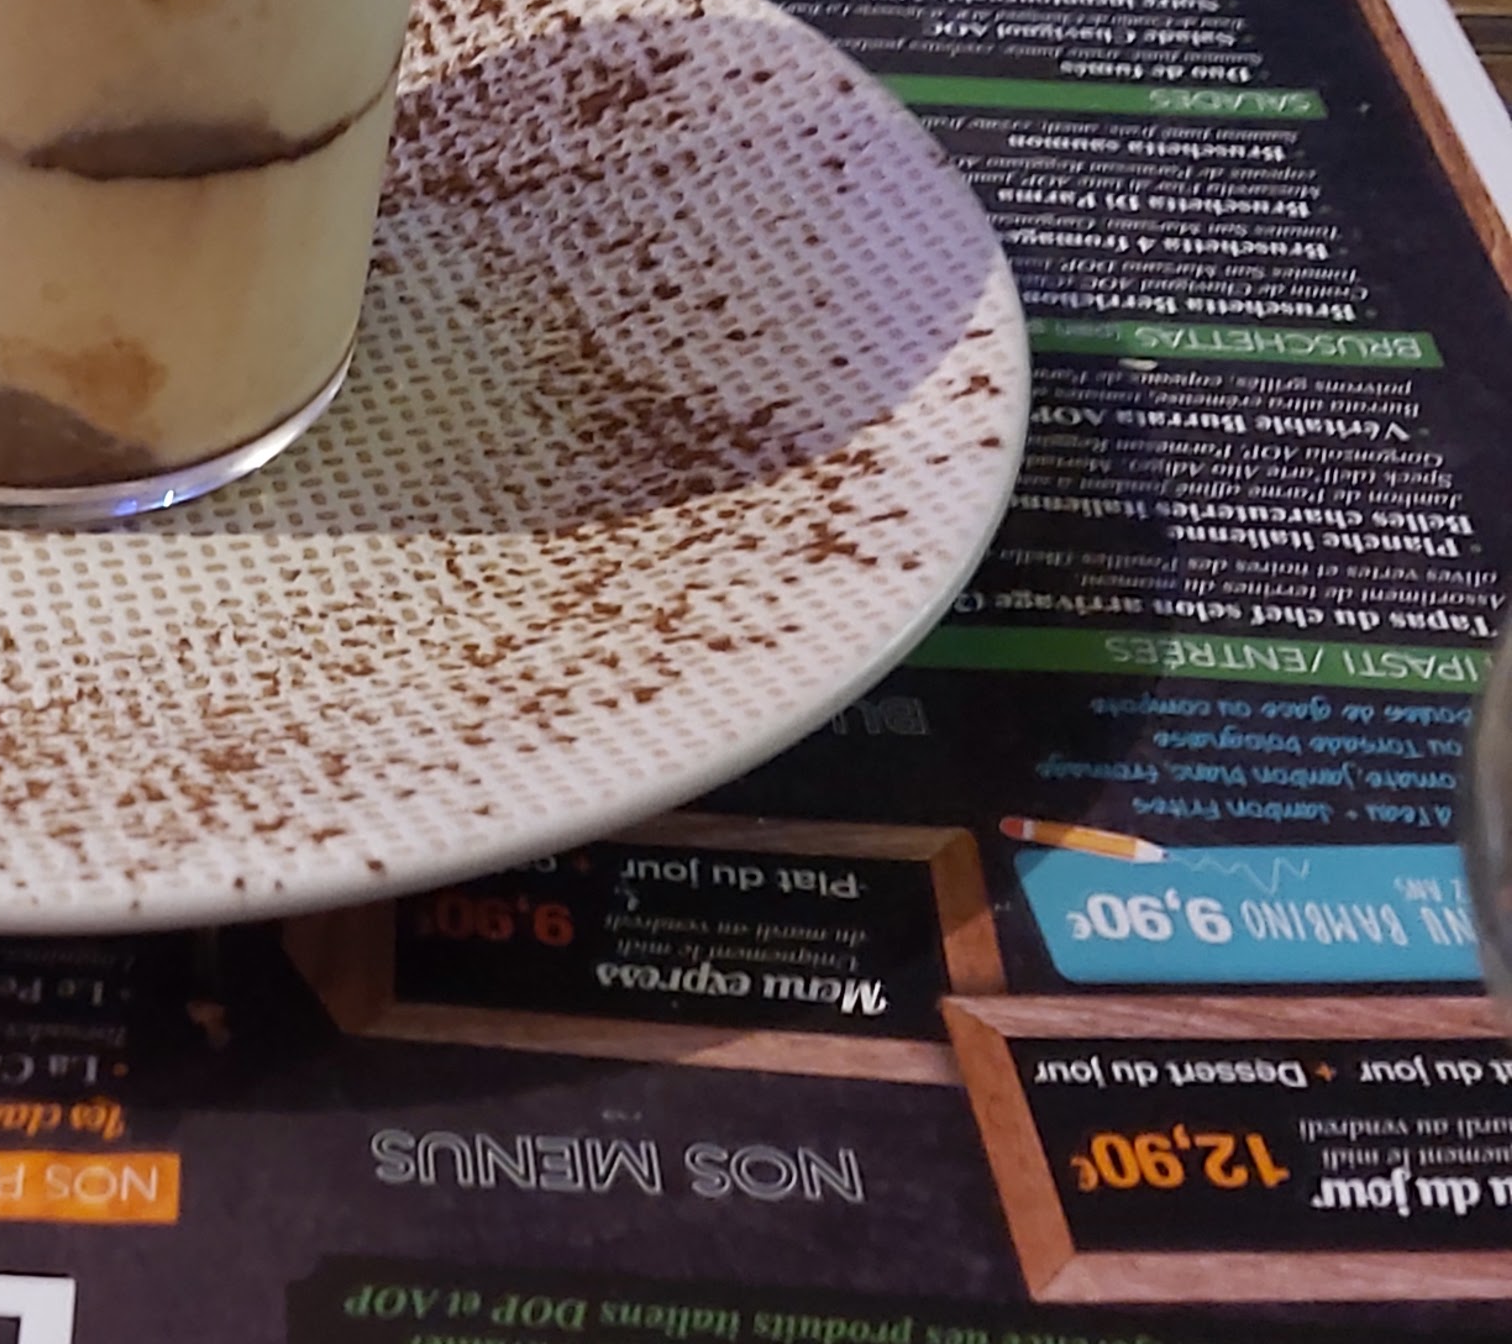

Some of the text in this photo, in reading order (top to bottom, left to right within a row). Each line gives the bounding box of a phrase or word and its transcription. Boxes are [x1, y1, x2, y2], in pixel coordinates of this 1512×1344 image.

[1134, 326, 1423, 360] BRUSCHETTAS
[1114, 407, 1411, 442] Véritable Burrata
[1154, 500, 1474, 536] Belles charcuteries
[1165, 523, 1460, 559] Planche italienne
[1151, 598, 1243, 623] selon
[1250, 603, 1324, 628] chef
[1333, 608, 1381, 632] du
[619, 857, 862, 901] Plat du jour
[593, 960, 888, 1017] Menu express
[47, 1053, 98, 1085] La
[1034, 1054, 1103, 1088] jour
[1112, 1059, 1158, 1088] du
[1166, 1058, 1308, 1089] Dessert
[1359, 1054, 1431, 1087] jour
[1434, 1060, 1483, 1087] du
[1298, 1116, 1408, 1143] vendredi
[370, 1128, 864, 1204] NOS MENUS
[44, 1163, 159, 1205] NOS
[1310, 1166, 1412, 1217] jour
[1414, 1176, 1480, 1216] du
[342, 1286, 441, 1320] AOP
[489, 1294, 587, 1332] DOP
[599, 1299, 741, 1342] italiens
